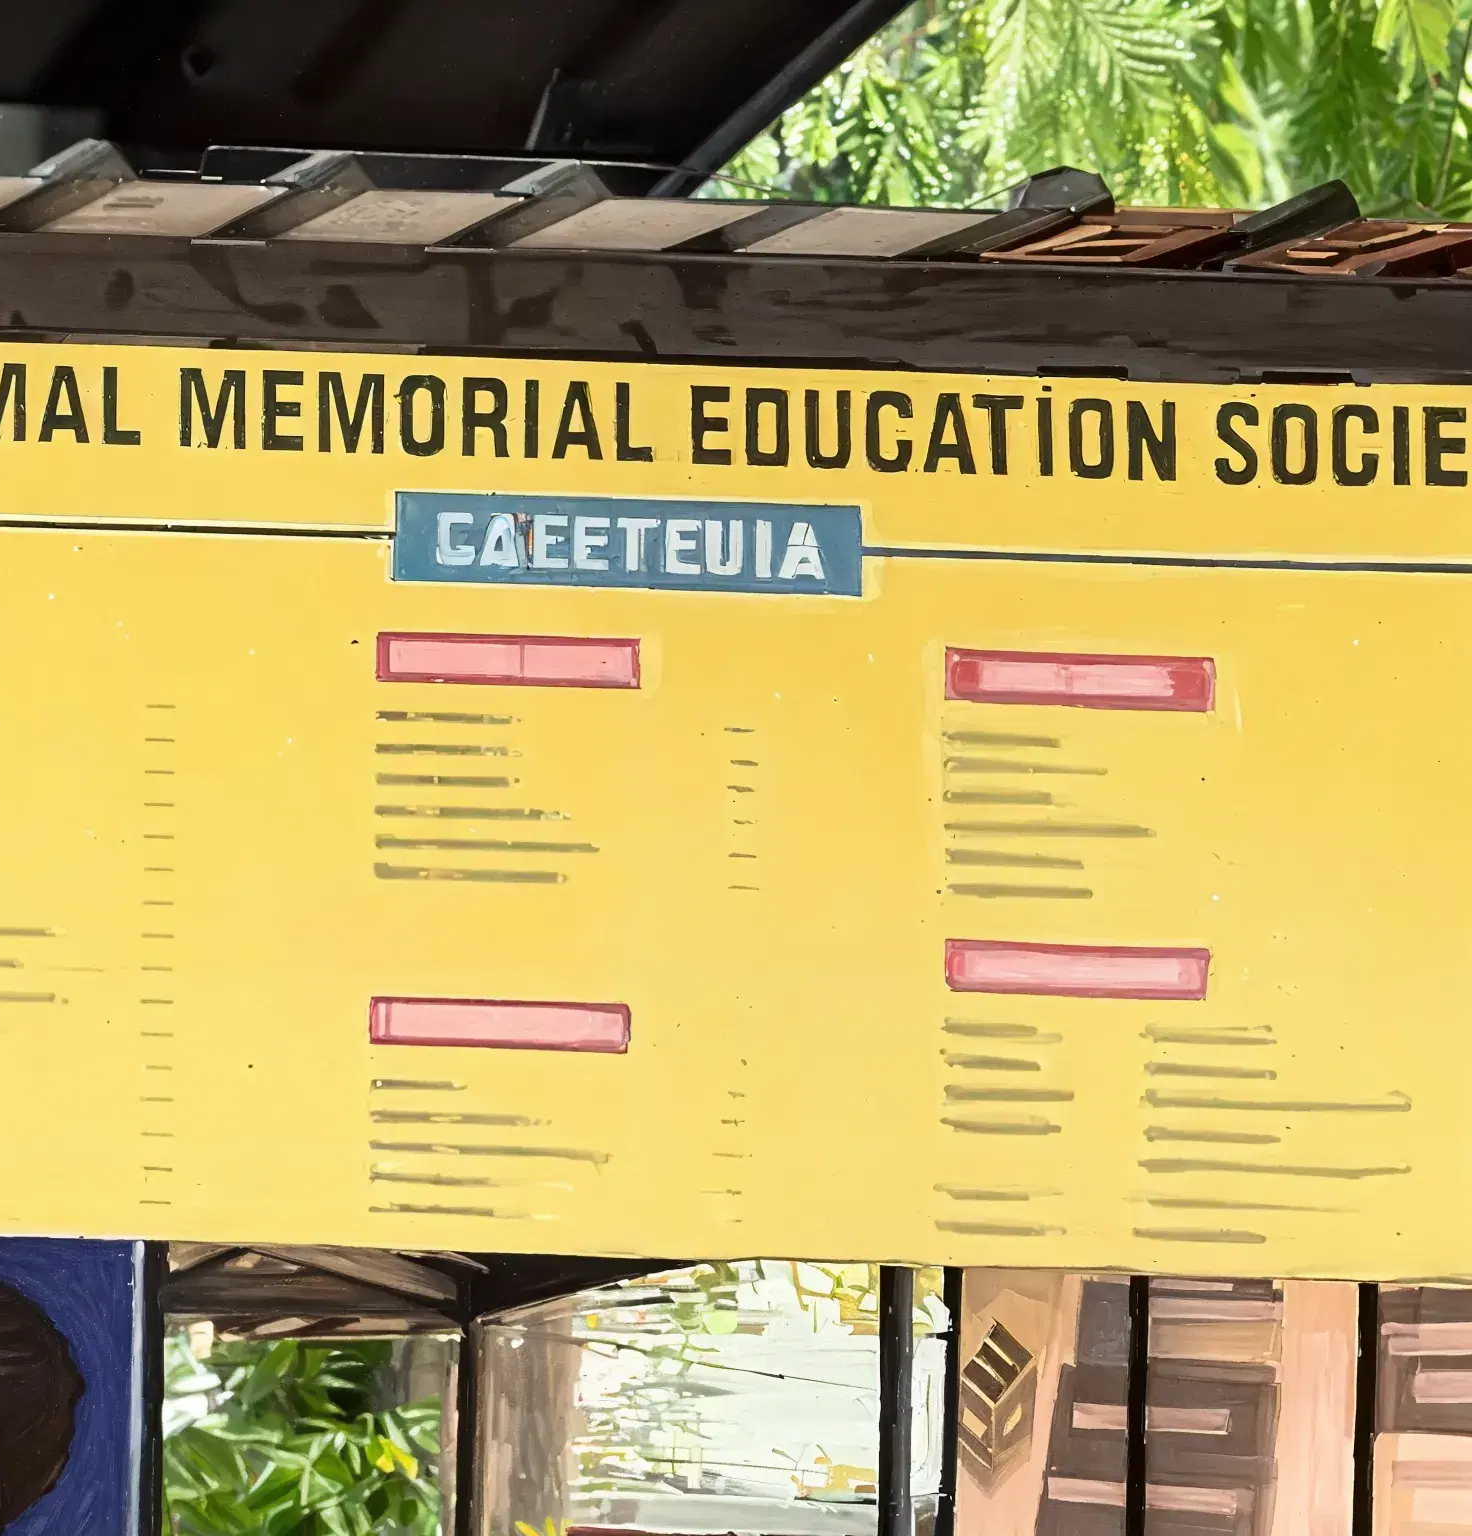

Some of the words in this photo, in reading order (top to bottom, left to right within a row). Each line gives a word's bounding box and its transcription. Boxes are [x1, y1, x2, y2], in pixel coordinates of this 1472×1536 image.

[180, 367, 652, 462] MEMORIAL
[691, 384, 1177, 481] EDUCATION
[1214, 401, 1468, 486] SOCIE
